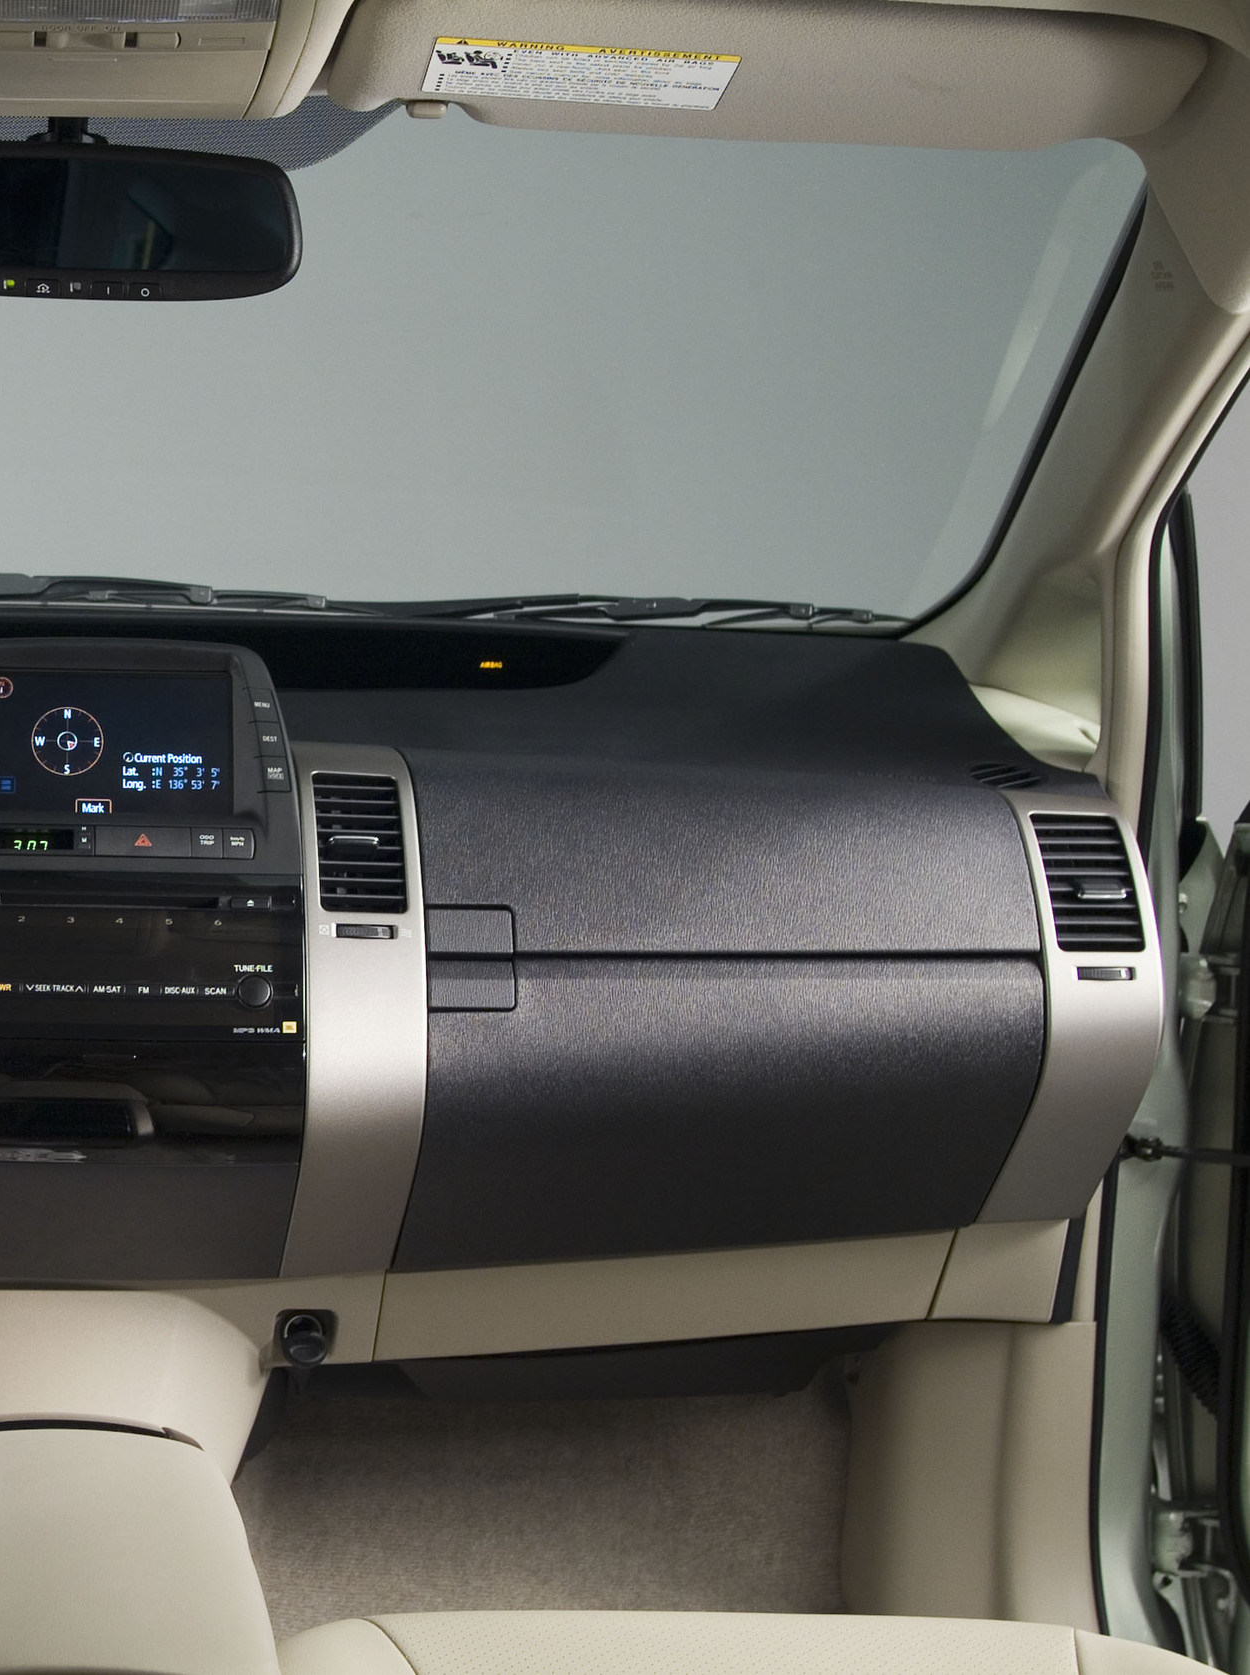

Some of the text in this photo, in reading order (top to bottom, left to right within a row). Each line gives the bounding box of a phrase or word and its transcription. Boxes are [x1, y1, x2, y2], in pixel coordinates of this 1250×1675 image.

[497, 41, 565, 51] WARNING
[63, 708, 72, 719] N
[34, 736, 46, 747] W
[93, 737, 101, 747] E
[262, 735, 278, 743] DEST
[134, 752, 203, 764] Current Position
[64, 764, 71, 775] S
[122, 765, 139, 777] Lat.
[122, 778, 147, 791] Long.
[81, 802, 105, 814] Mark
[67, 915, 75, 923] 3
[115, 916, 124, 924] 4
[165, 918, 173, 926] 5
[214, 918, 222, 926] 6
[138, 986, 150, 995] FM
[204, 987, 227, 996] SCAN
